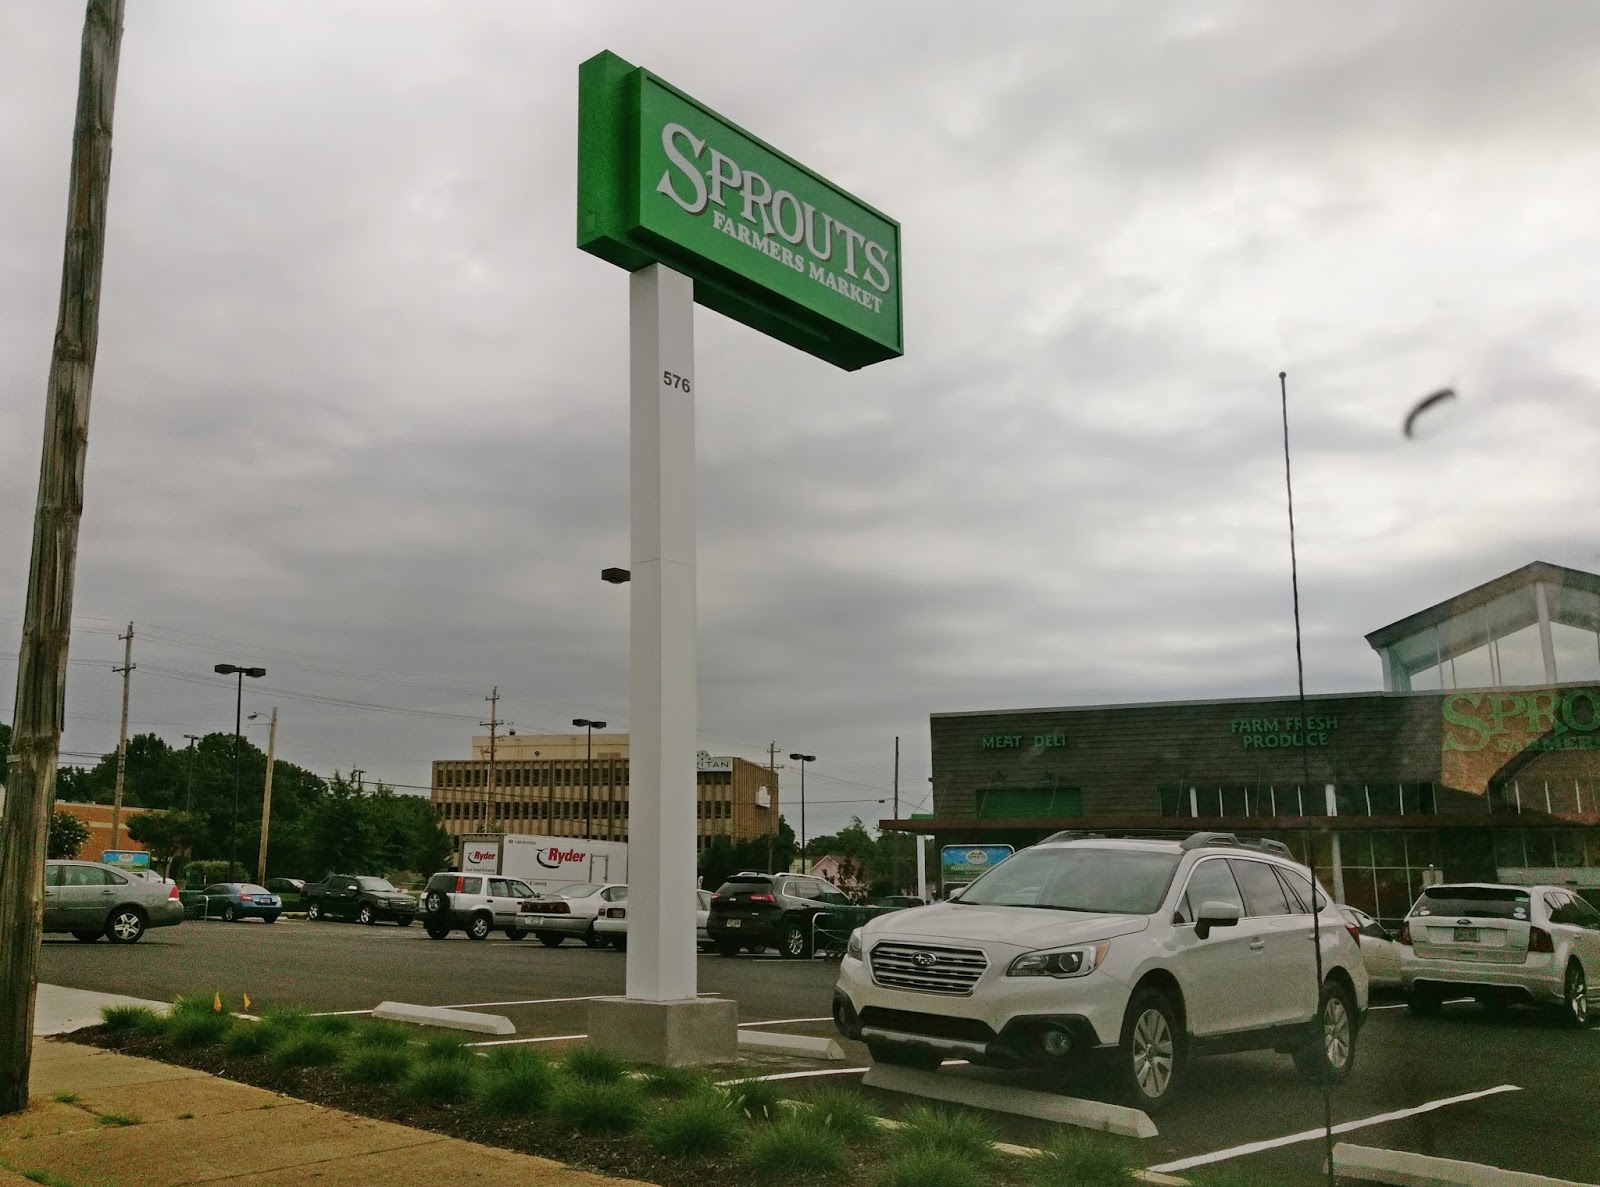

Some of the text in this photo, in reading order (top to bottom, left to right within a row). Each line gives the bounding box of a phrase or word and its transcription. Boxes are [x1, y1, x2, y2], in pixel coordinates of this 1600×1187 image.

[656, 122, 891, 293] SPROUTS
[712, 209, 883, 314] FARMERS MARKET
[663, 370, 691, 393] 576
[1231, 716, 1339, 733] FARM FRESH
[982, 731, 1066, 749] MEAT DELI
[1242, 732, 1329, 748] PRODUCE
[473, 851, 496, 861] Ryder
[547, 847, 586, 864] Ryder
